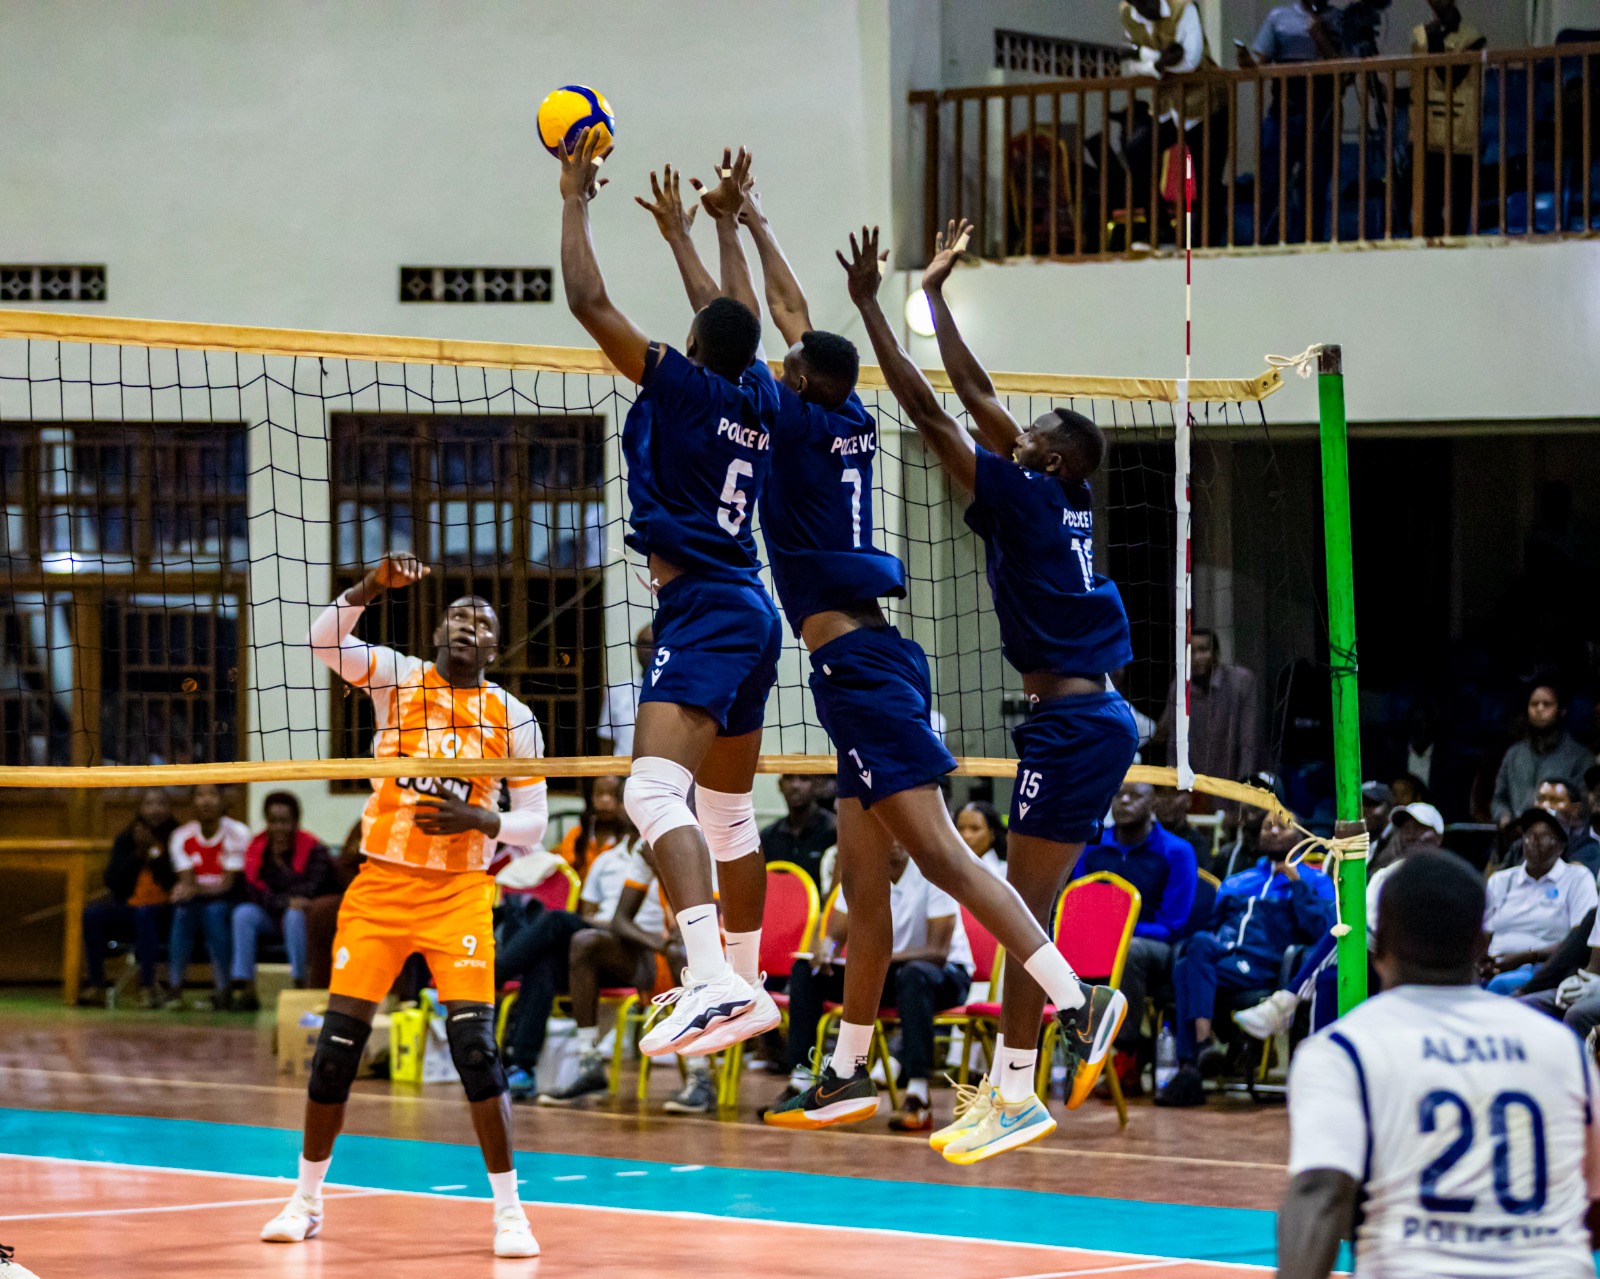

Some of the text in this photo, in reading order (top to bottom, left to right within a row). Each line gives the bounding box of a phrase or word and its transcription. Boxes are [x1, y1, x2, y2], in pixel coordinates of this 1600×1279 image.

[858, 432, 876, 453] VC
[717, 458, 753, 536] 5
[841, 468, 862, 547] 7
[1063, 507, 1089, 528] POLICE
[655, 646, 671, 667] 5
[848, 747, 864, 770] 7
[1019, 768, 1043, 799] 15
[462, 934, 477, 957] 9
[1422, 1035, 1527, 1064] ALAIN
[1418, 1088, 1548, 1216] 20
